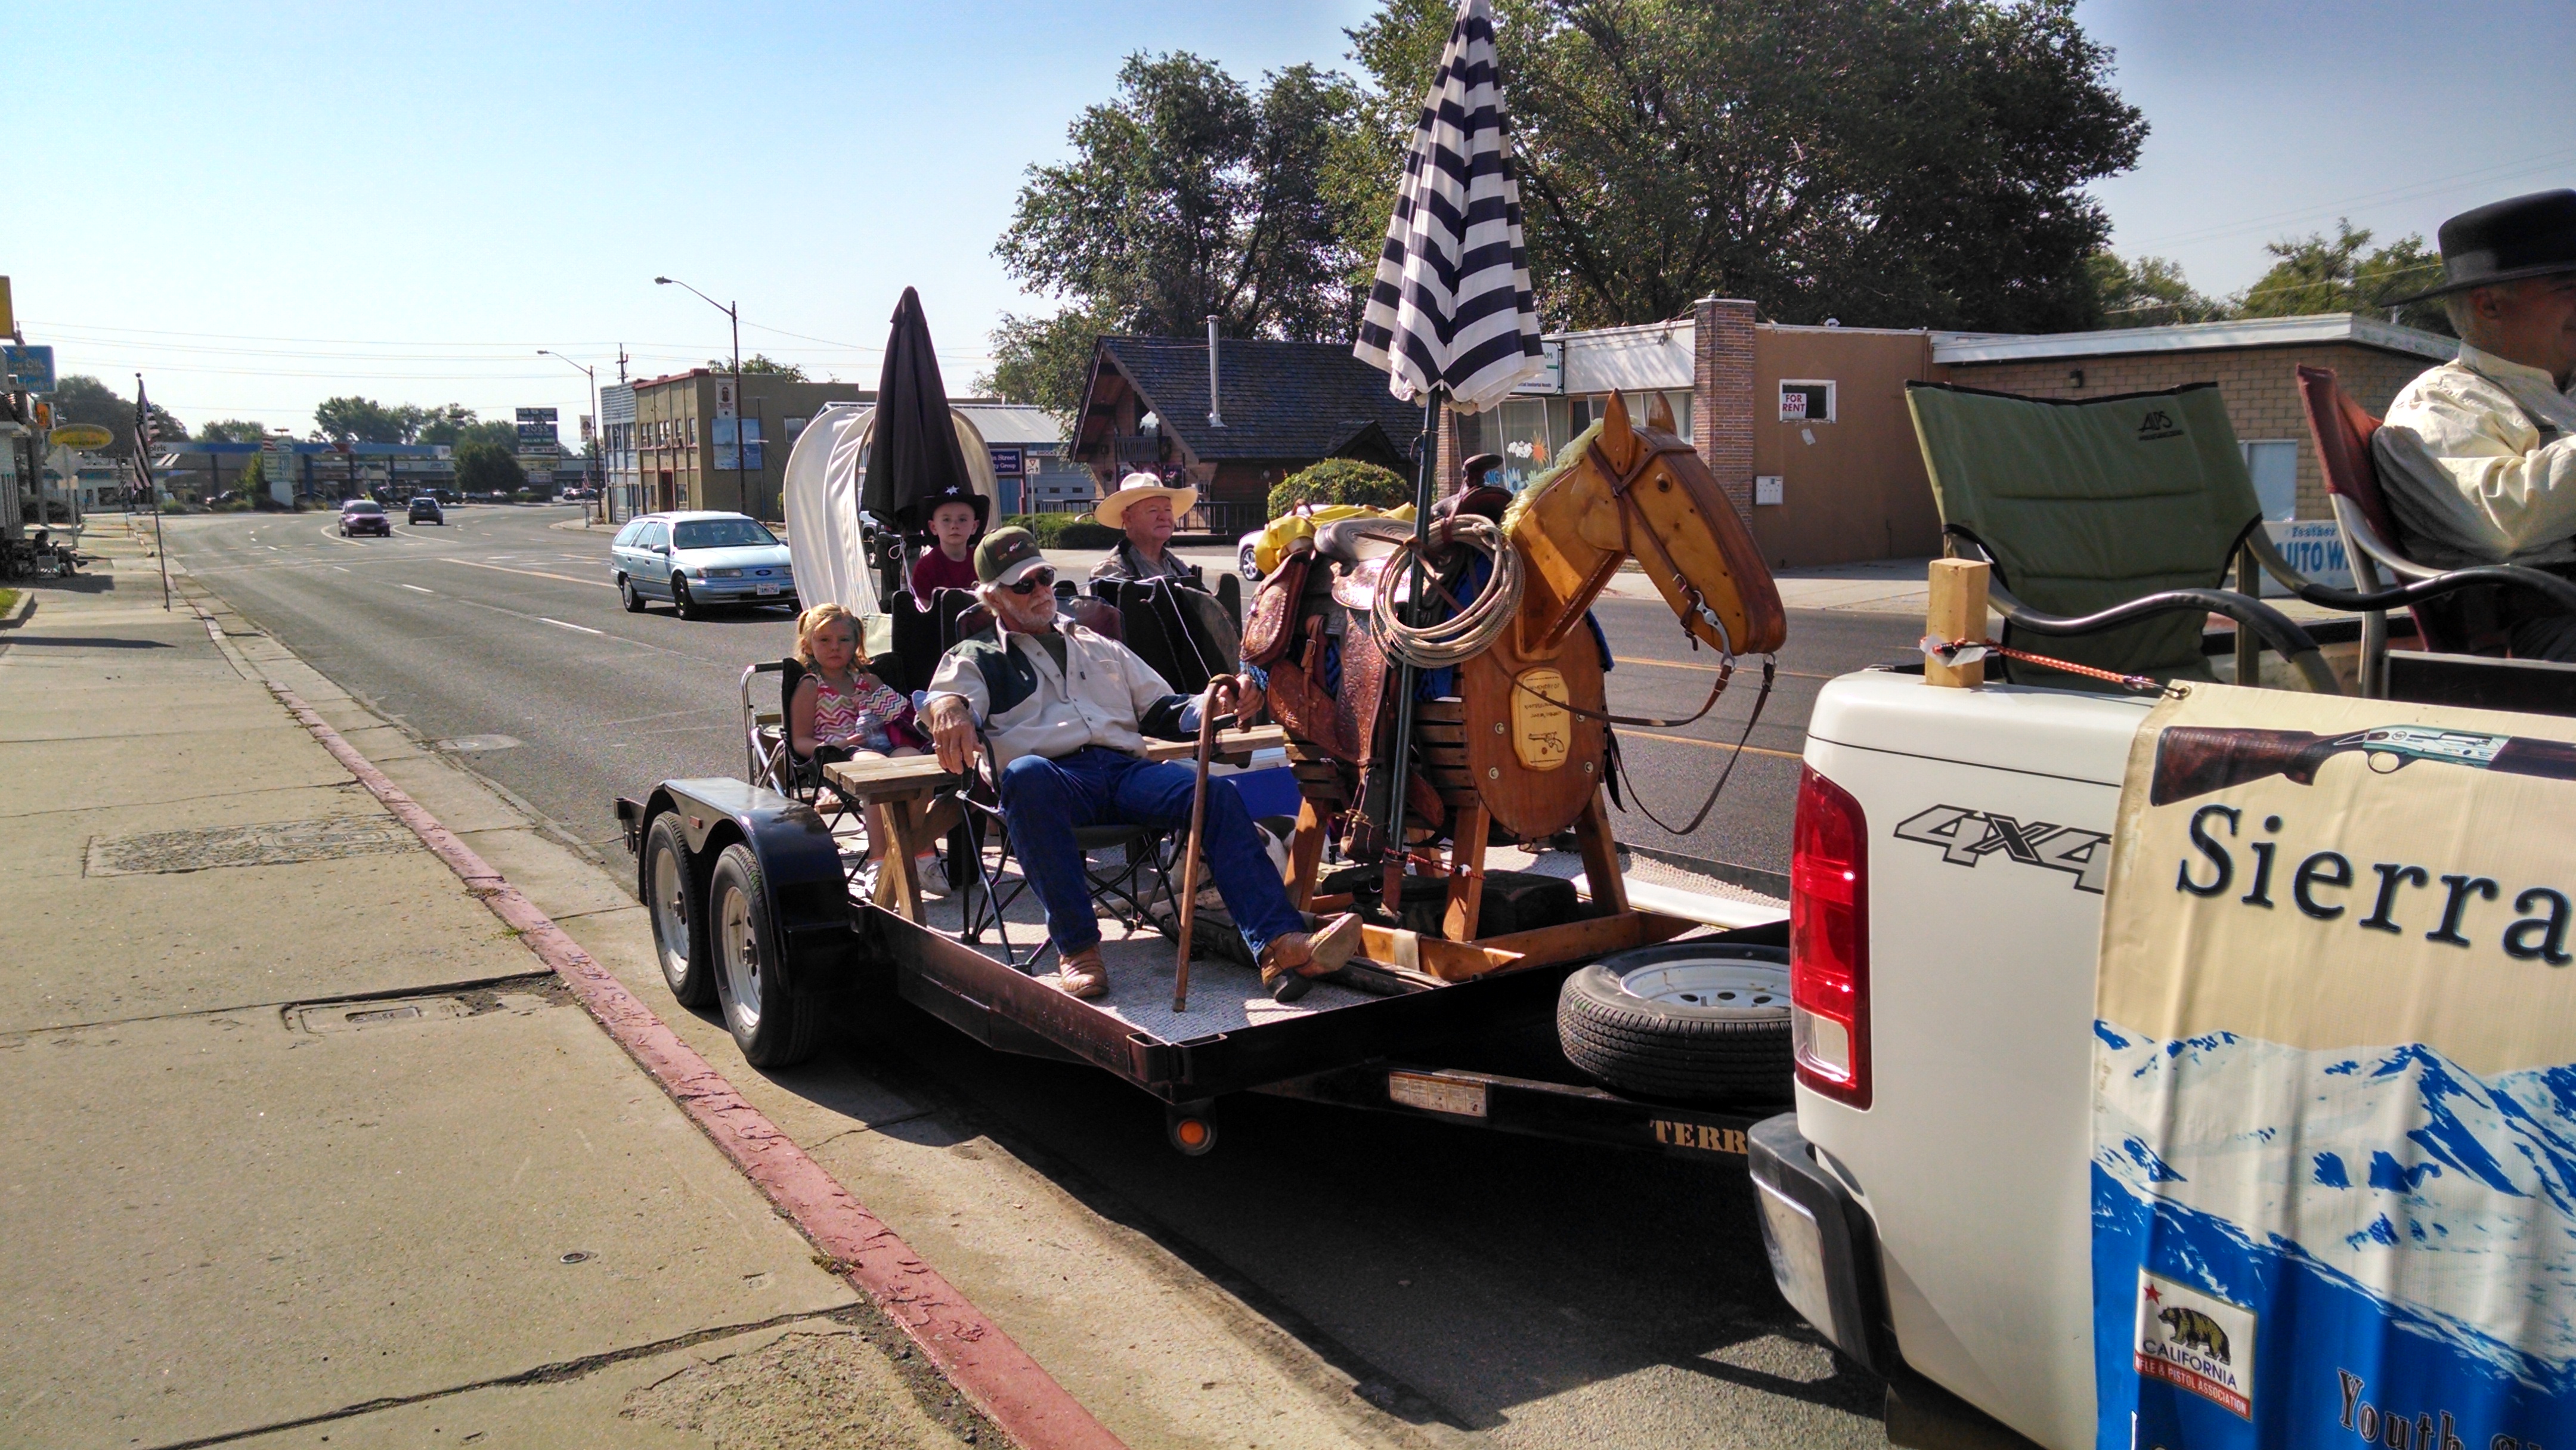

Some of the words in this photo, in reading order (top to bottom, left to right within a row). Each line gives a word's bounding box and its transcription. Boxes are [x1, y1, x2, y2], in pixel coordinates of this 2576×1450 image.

[1782, 403, 1805, 411] RENT
[1785, 394, 1802, 402] FOR
[148, 444, 166, 453] pirit
[2291, 524, 2336, 537] Feather
[2175, 804, 2573, 966] Sierra
[1649, 1120, 1748, 1155] TERR
[2143, 1339, 2237, 1390] CALIFORNIA
[2158, 1362, 2165, 1376] &
[2168, 1365, 2197, 1389] PISTOL
[2198, 1378, 2246, 1415] ASSOCIATION
[2337, 1367, 2465, 1450] Youth
